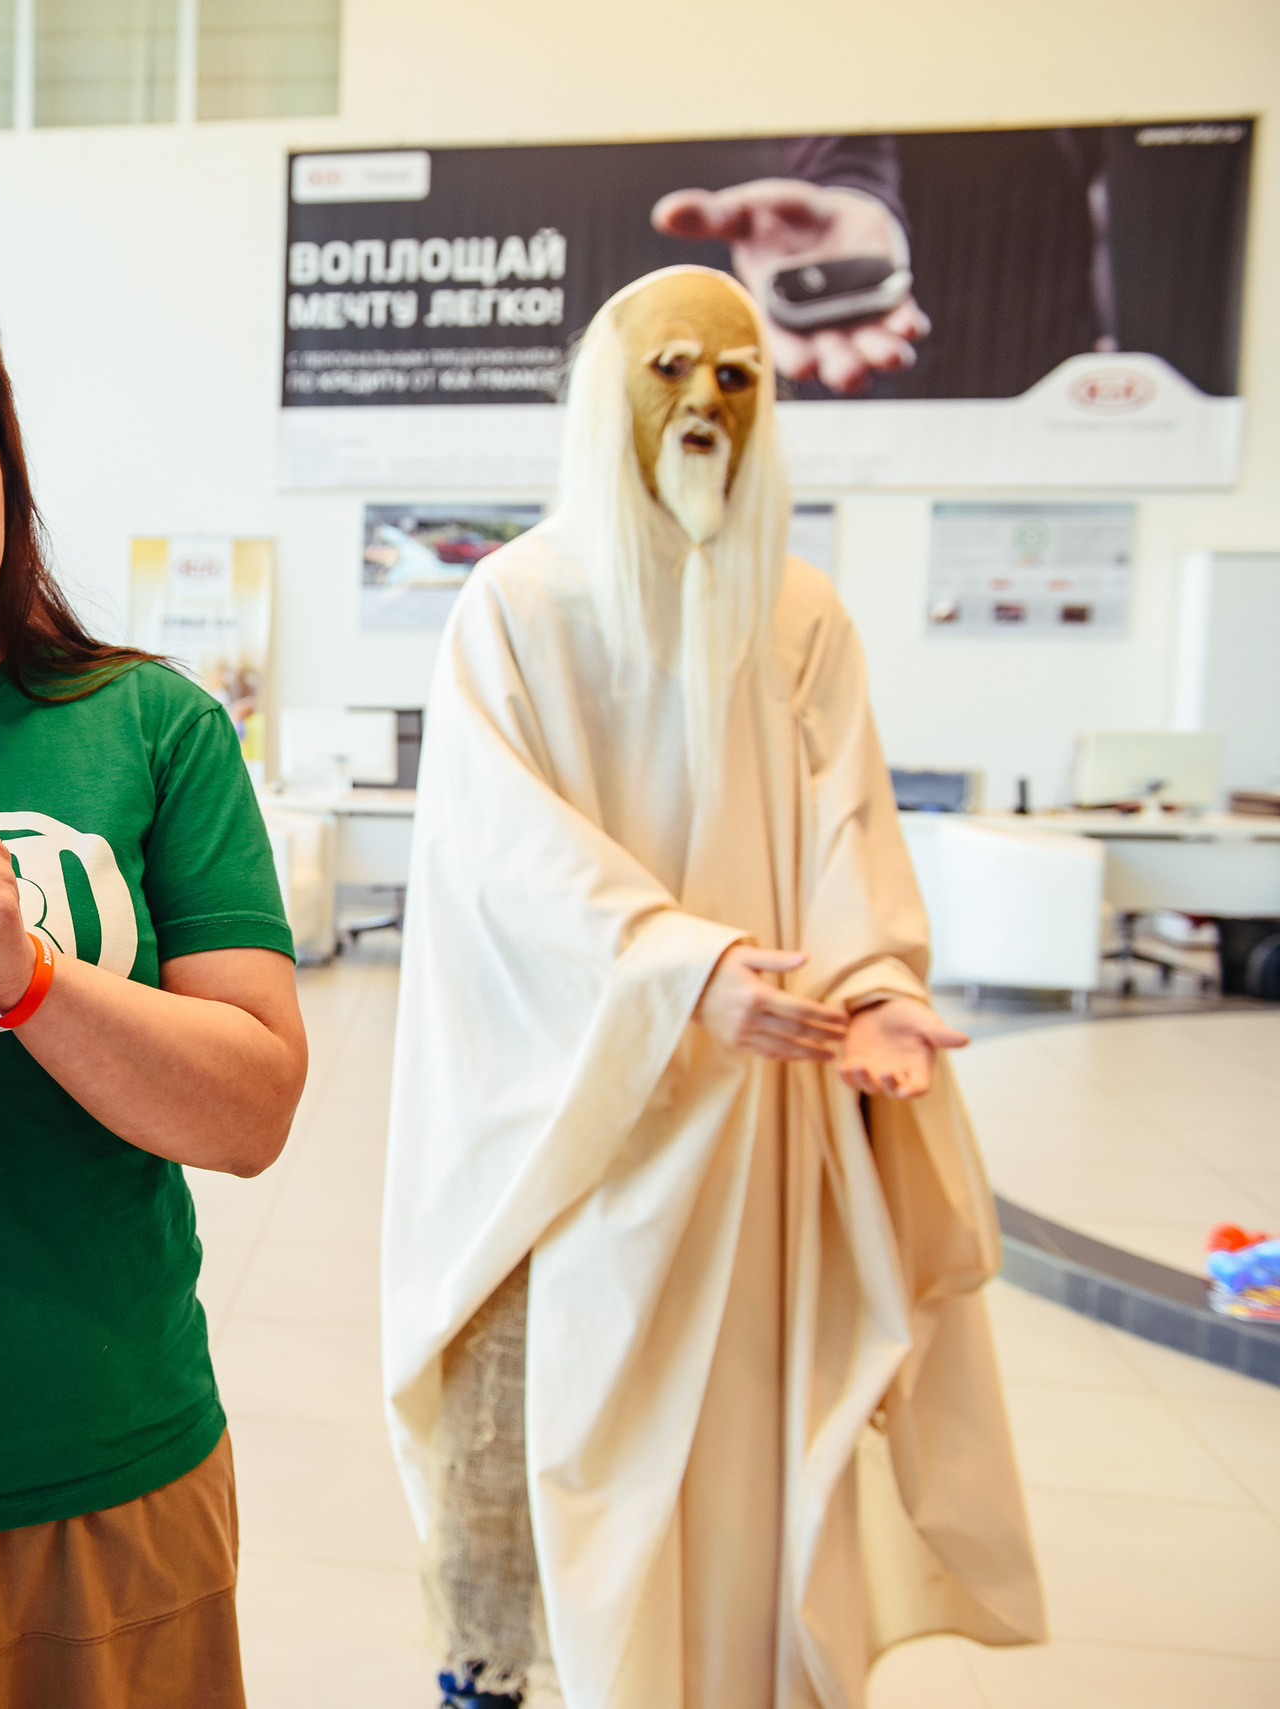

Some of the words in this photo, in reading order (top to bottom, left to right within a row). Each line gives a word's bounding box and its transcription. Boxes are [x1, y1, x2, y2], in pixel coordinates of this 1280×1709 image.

[289, 228, 566, 287] ВОПЛОЩАЙ
[288, 290, 418, 329] МЕЧТУ
[423, 286, 564, 328] ЛЕГКО!
